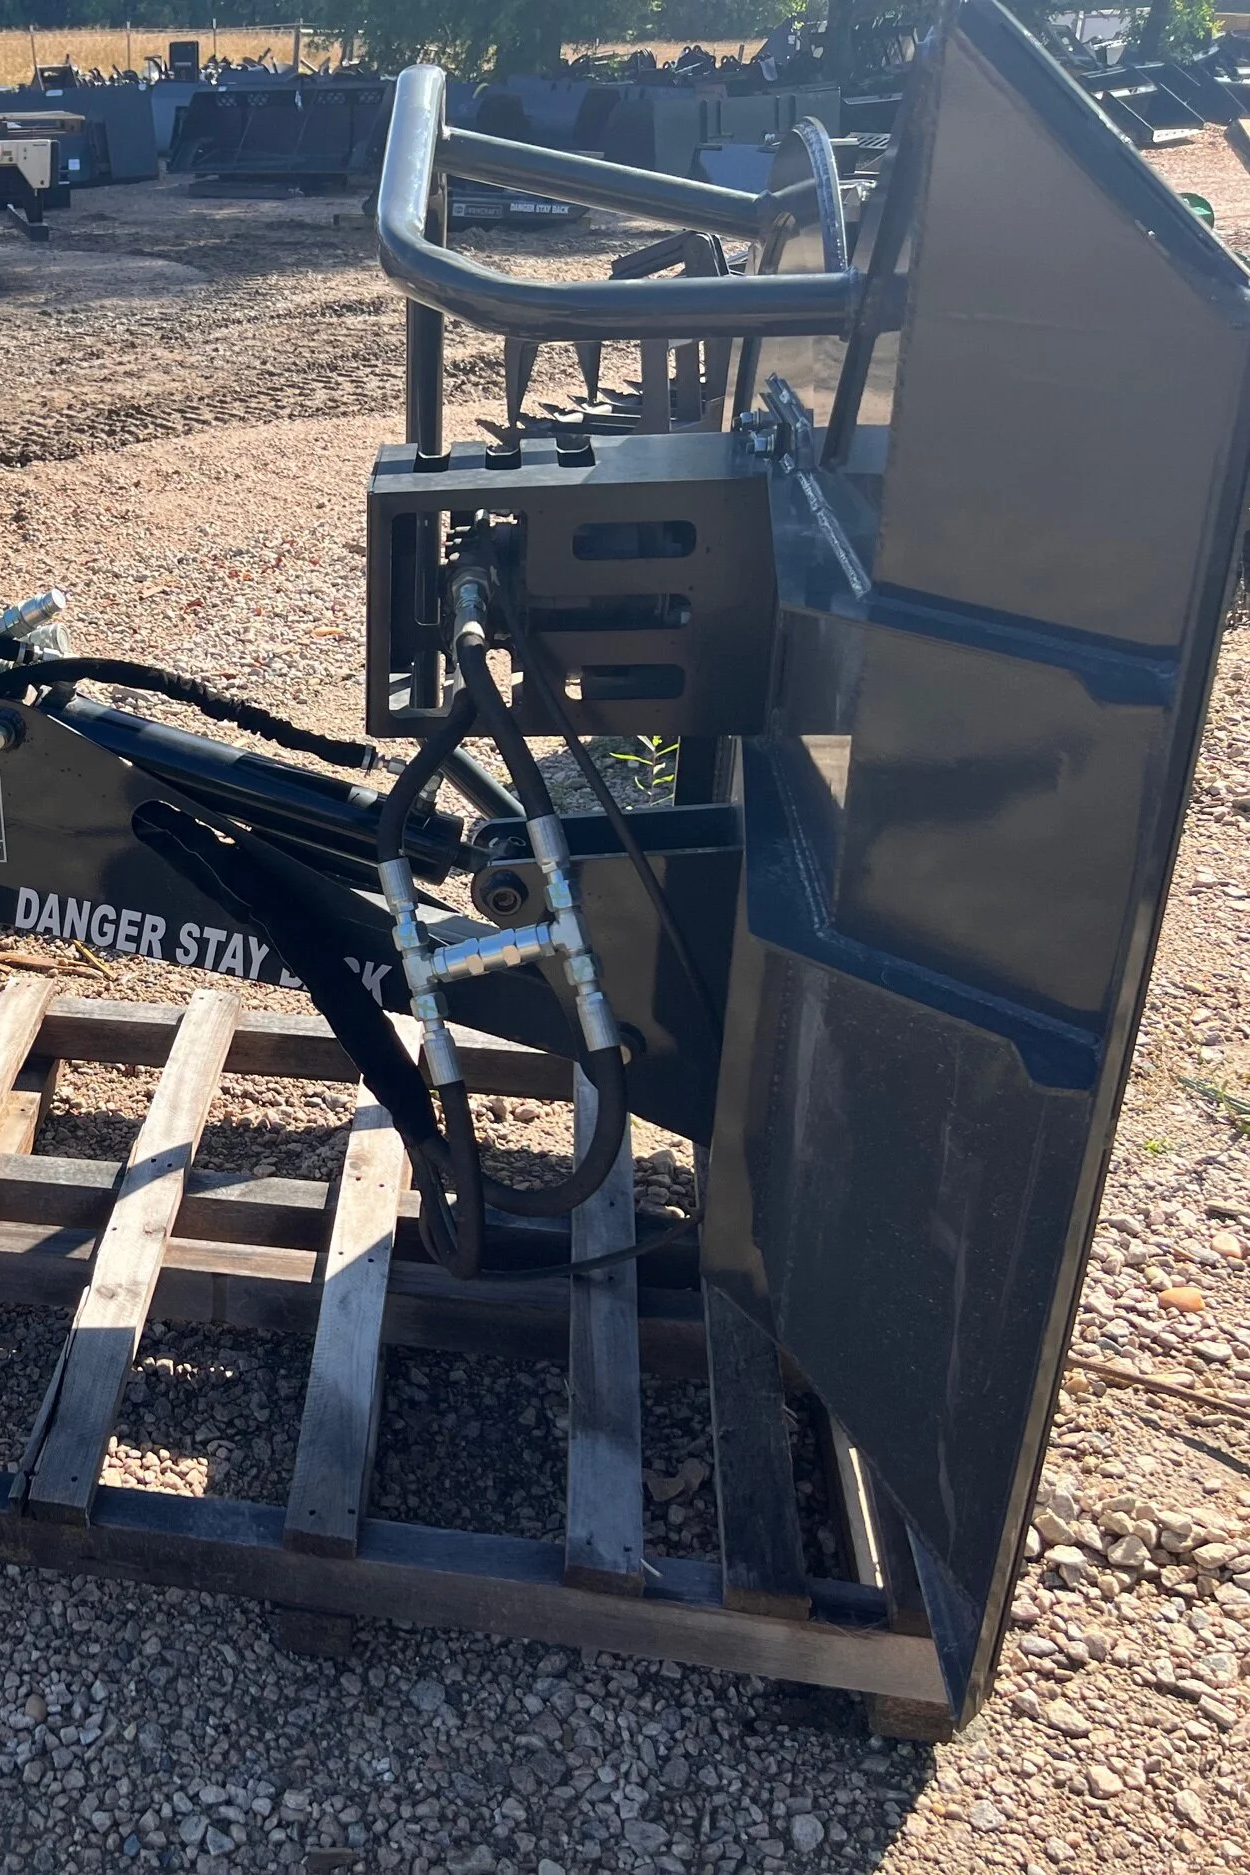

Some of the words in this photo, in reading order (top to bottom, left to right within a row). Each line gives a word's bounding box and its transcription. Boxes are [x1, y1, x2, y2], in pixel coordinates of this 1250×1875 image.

[510, 203, 535, 212] DANGER
[535, 204, 552, 213] STAY
[552, 205, 569, 214] BACK
[15, 886, 168, 959] DANGER
[176, 922, 270, 980] STAY
